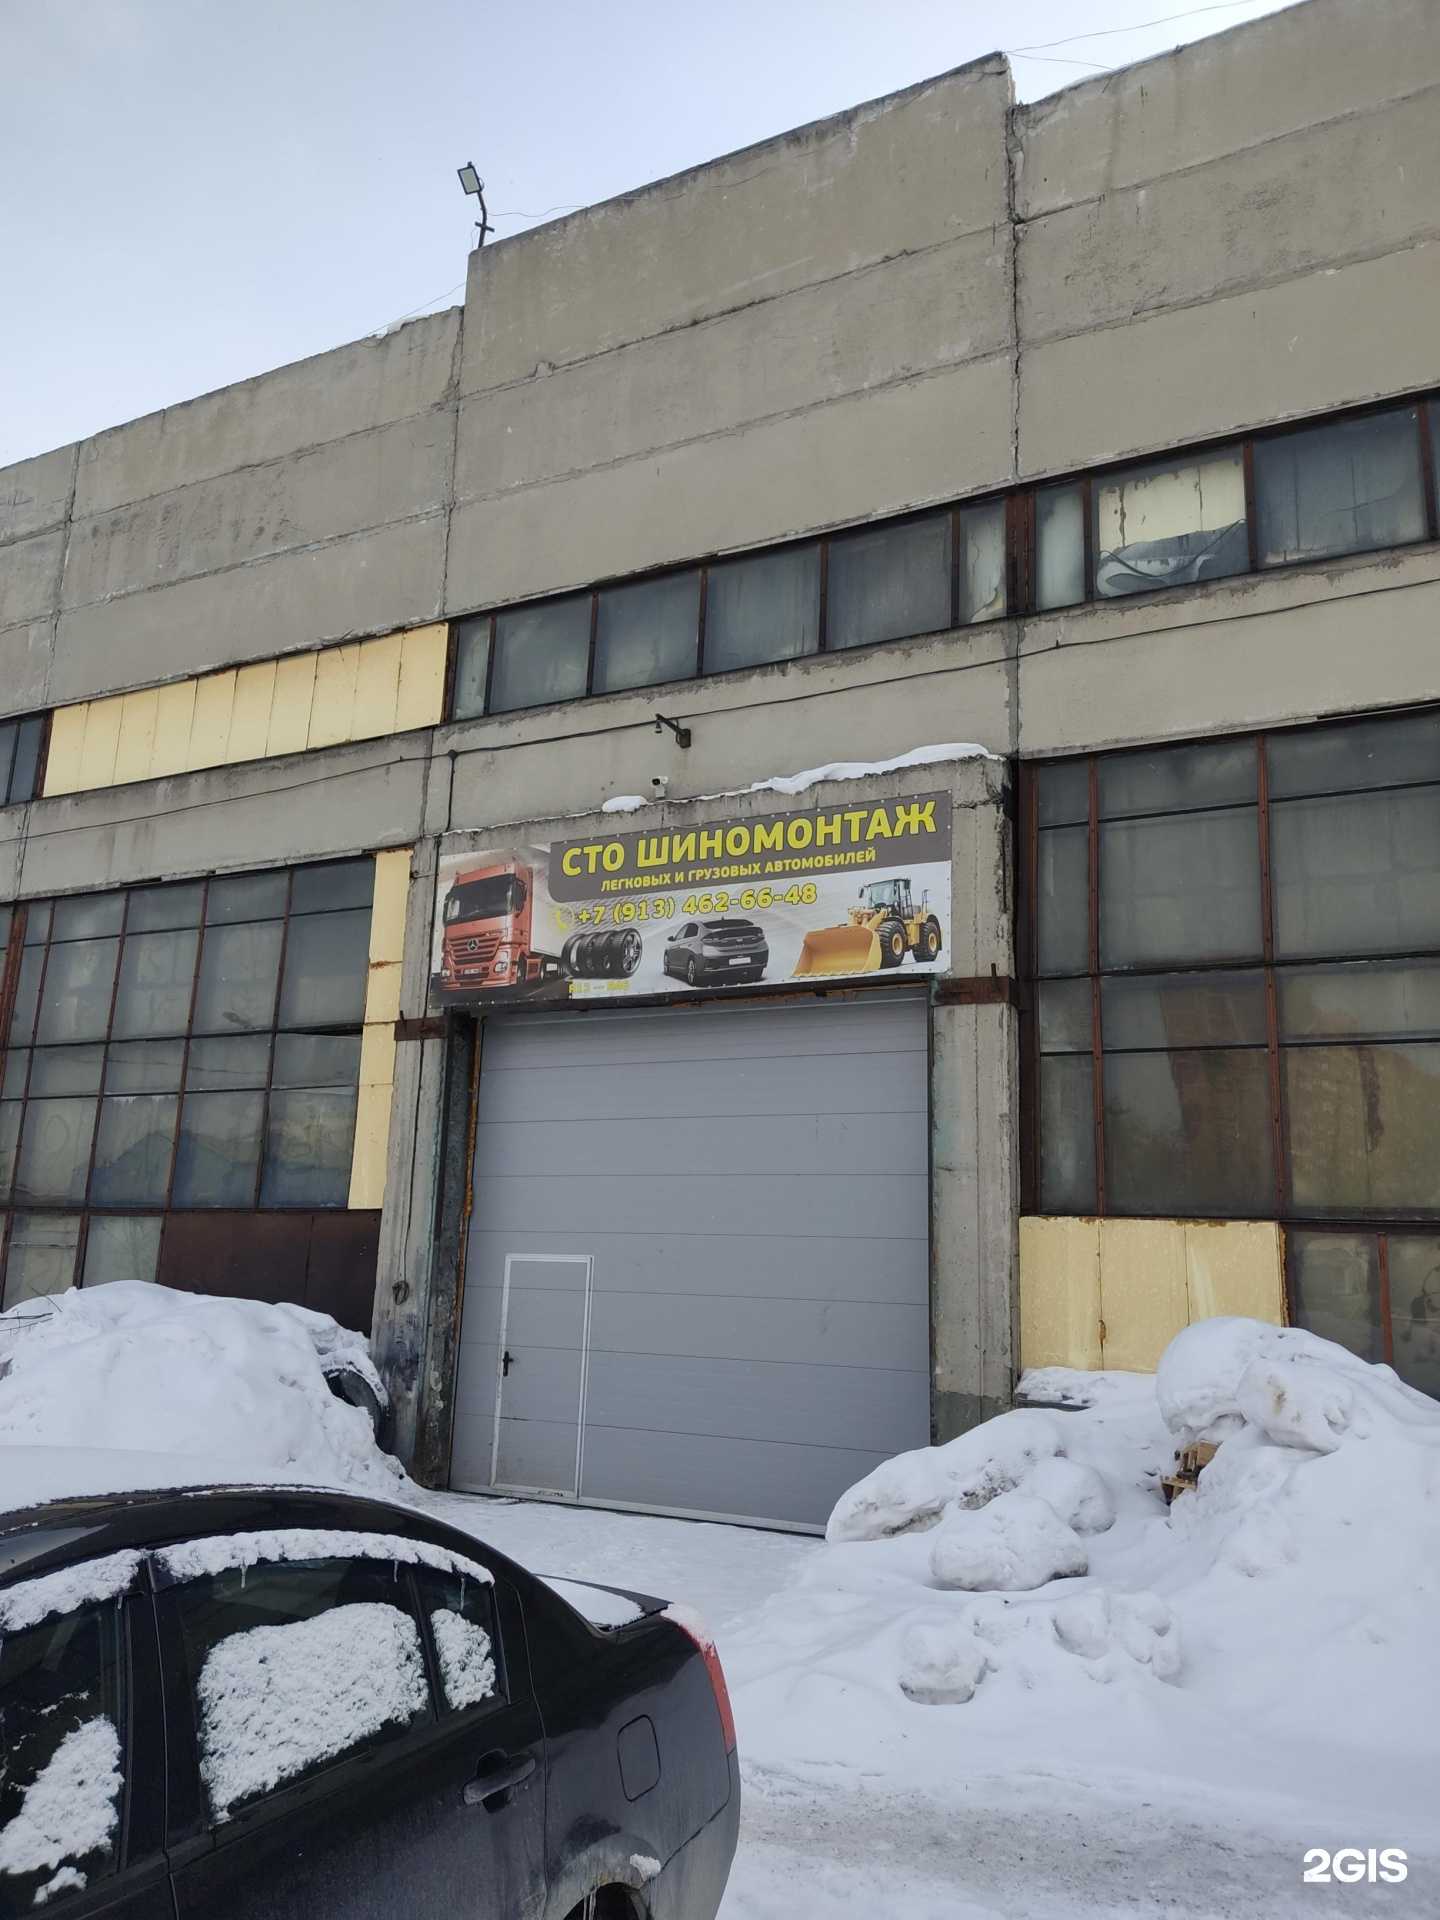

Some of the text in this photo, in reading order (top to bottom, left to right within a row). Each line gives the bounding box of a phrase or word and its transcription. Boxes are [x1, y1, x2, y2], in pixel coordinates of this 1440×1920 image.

[563, 801, 937, 877] СТО ШИНОМОНТАЖ
[601, 848, 876, 892] ЛЕГКОВЫХ И ГРУЗОВЫХ АВТОМОБИЛЕЙ
[578, 882, 818, 925] +7 (913) 462-66-48
